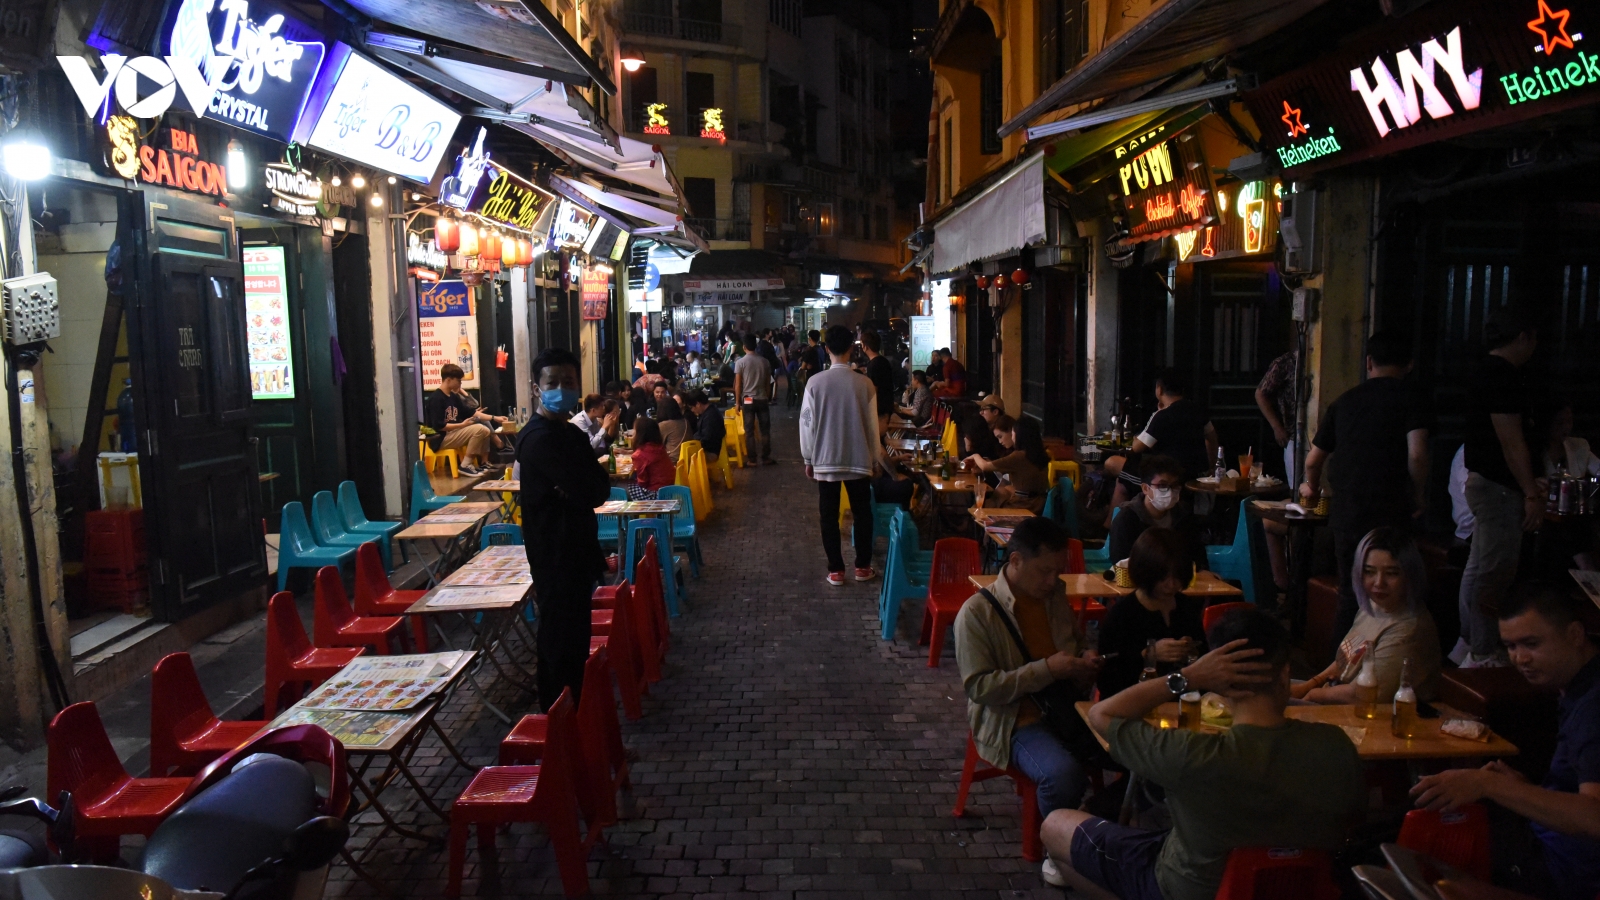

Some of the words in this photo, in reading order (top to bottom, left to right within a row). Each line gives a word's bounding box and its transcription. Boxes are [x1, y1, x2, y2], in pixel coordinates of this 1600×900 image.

[214, 0, 304, 93] Tiger
[1500, 52, 1600, 104] Heinek
[207, 90, 269, 131] CRYSTAL
[333, 102, 367, 138] Tiger
[171, 128, 199, 155] BIA
[644, 126, 670, 135] SAIGON
[701, 131, 725, 140] SAIGON
[1277, 127, 1341, 168] Heineken
[139, 145, 228, 197] SAIGON
[265, 167, 322, 199] STRONGB
[1119, 141, 1174, 196] POW
[420, 288, 466, 313] Tiger
[733, 281, 753, 289] LOAN
